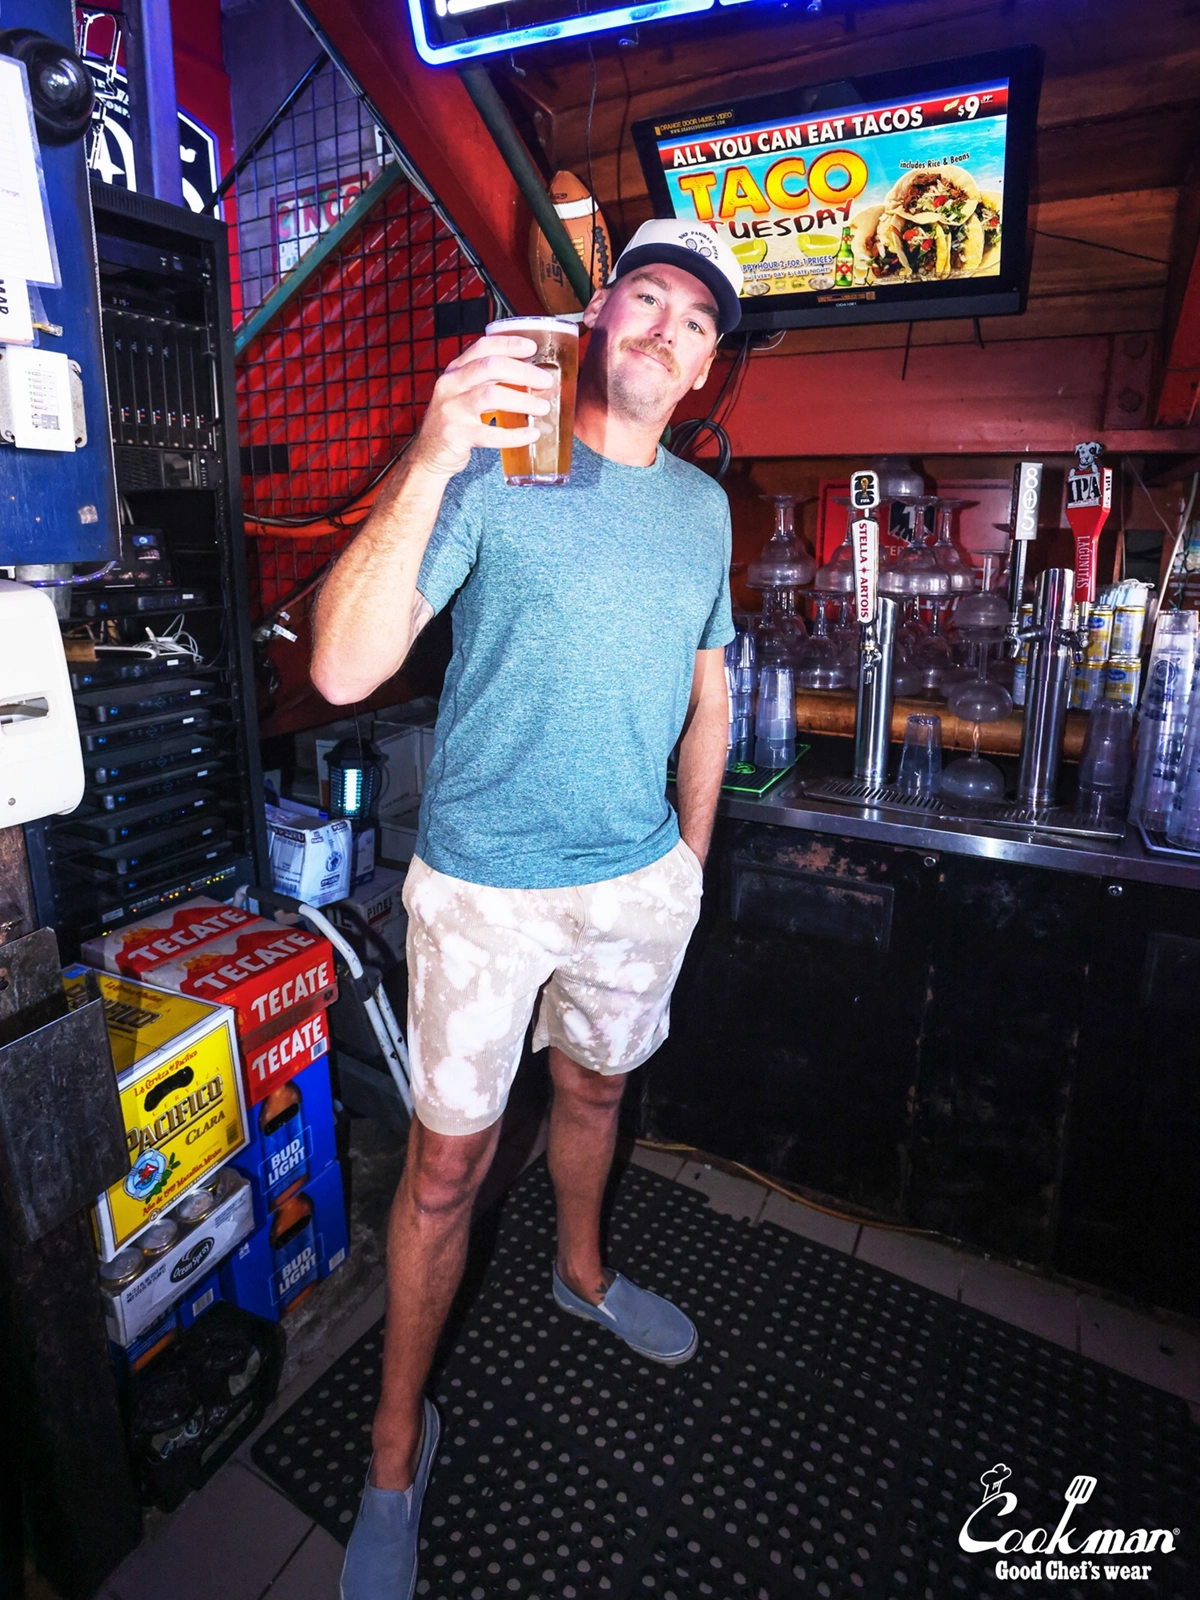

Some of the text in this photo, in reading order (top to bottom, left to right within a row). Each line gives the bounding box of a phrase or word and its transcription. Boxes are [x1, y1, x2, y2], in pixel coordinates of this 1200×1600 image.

[673, 106, 923, 167] ALL YOU CAN EAT TACOS
[927, 160, 941, 168] Rice
[950, 152, 970, 164] Beans
[678, 148, 868, 221] TACO
[702, 198, 854, 240] TUESDAY
[758, 261, 778, 271] HOUR
[808, 256, 833, 265] PRICES
[1020, 467, 1038, 531] 805
[1067, 475, 1102, 504] IPA
[859, 522, 869, 618] STELLA ARTOIS
[1076, 535, 1090, 589] LAGUNITAS
[127, 909, 248, 961] TECATE
[193, 932, 316, 990] TECATE
[251, 961, 329, 1023] TECATE
[252, 1014, 323, 1081] TECATE
[268, 1146, 305, 1186] LIGHT
[271, 1138, 300, 1170] BUD
[173, 1262, 193, 1279] Ocean
[279, 1253, 317, 1295] LIGHT
[282, 1246, 311, 1279] BUD
